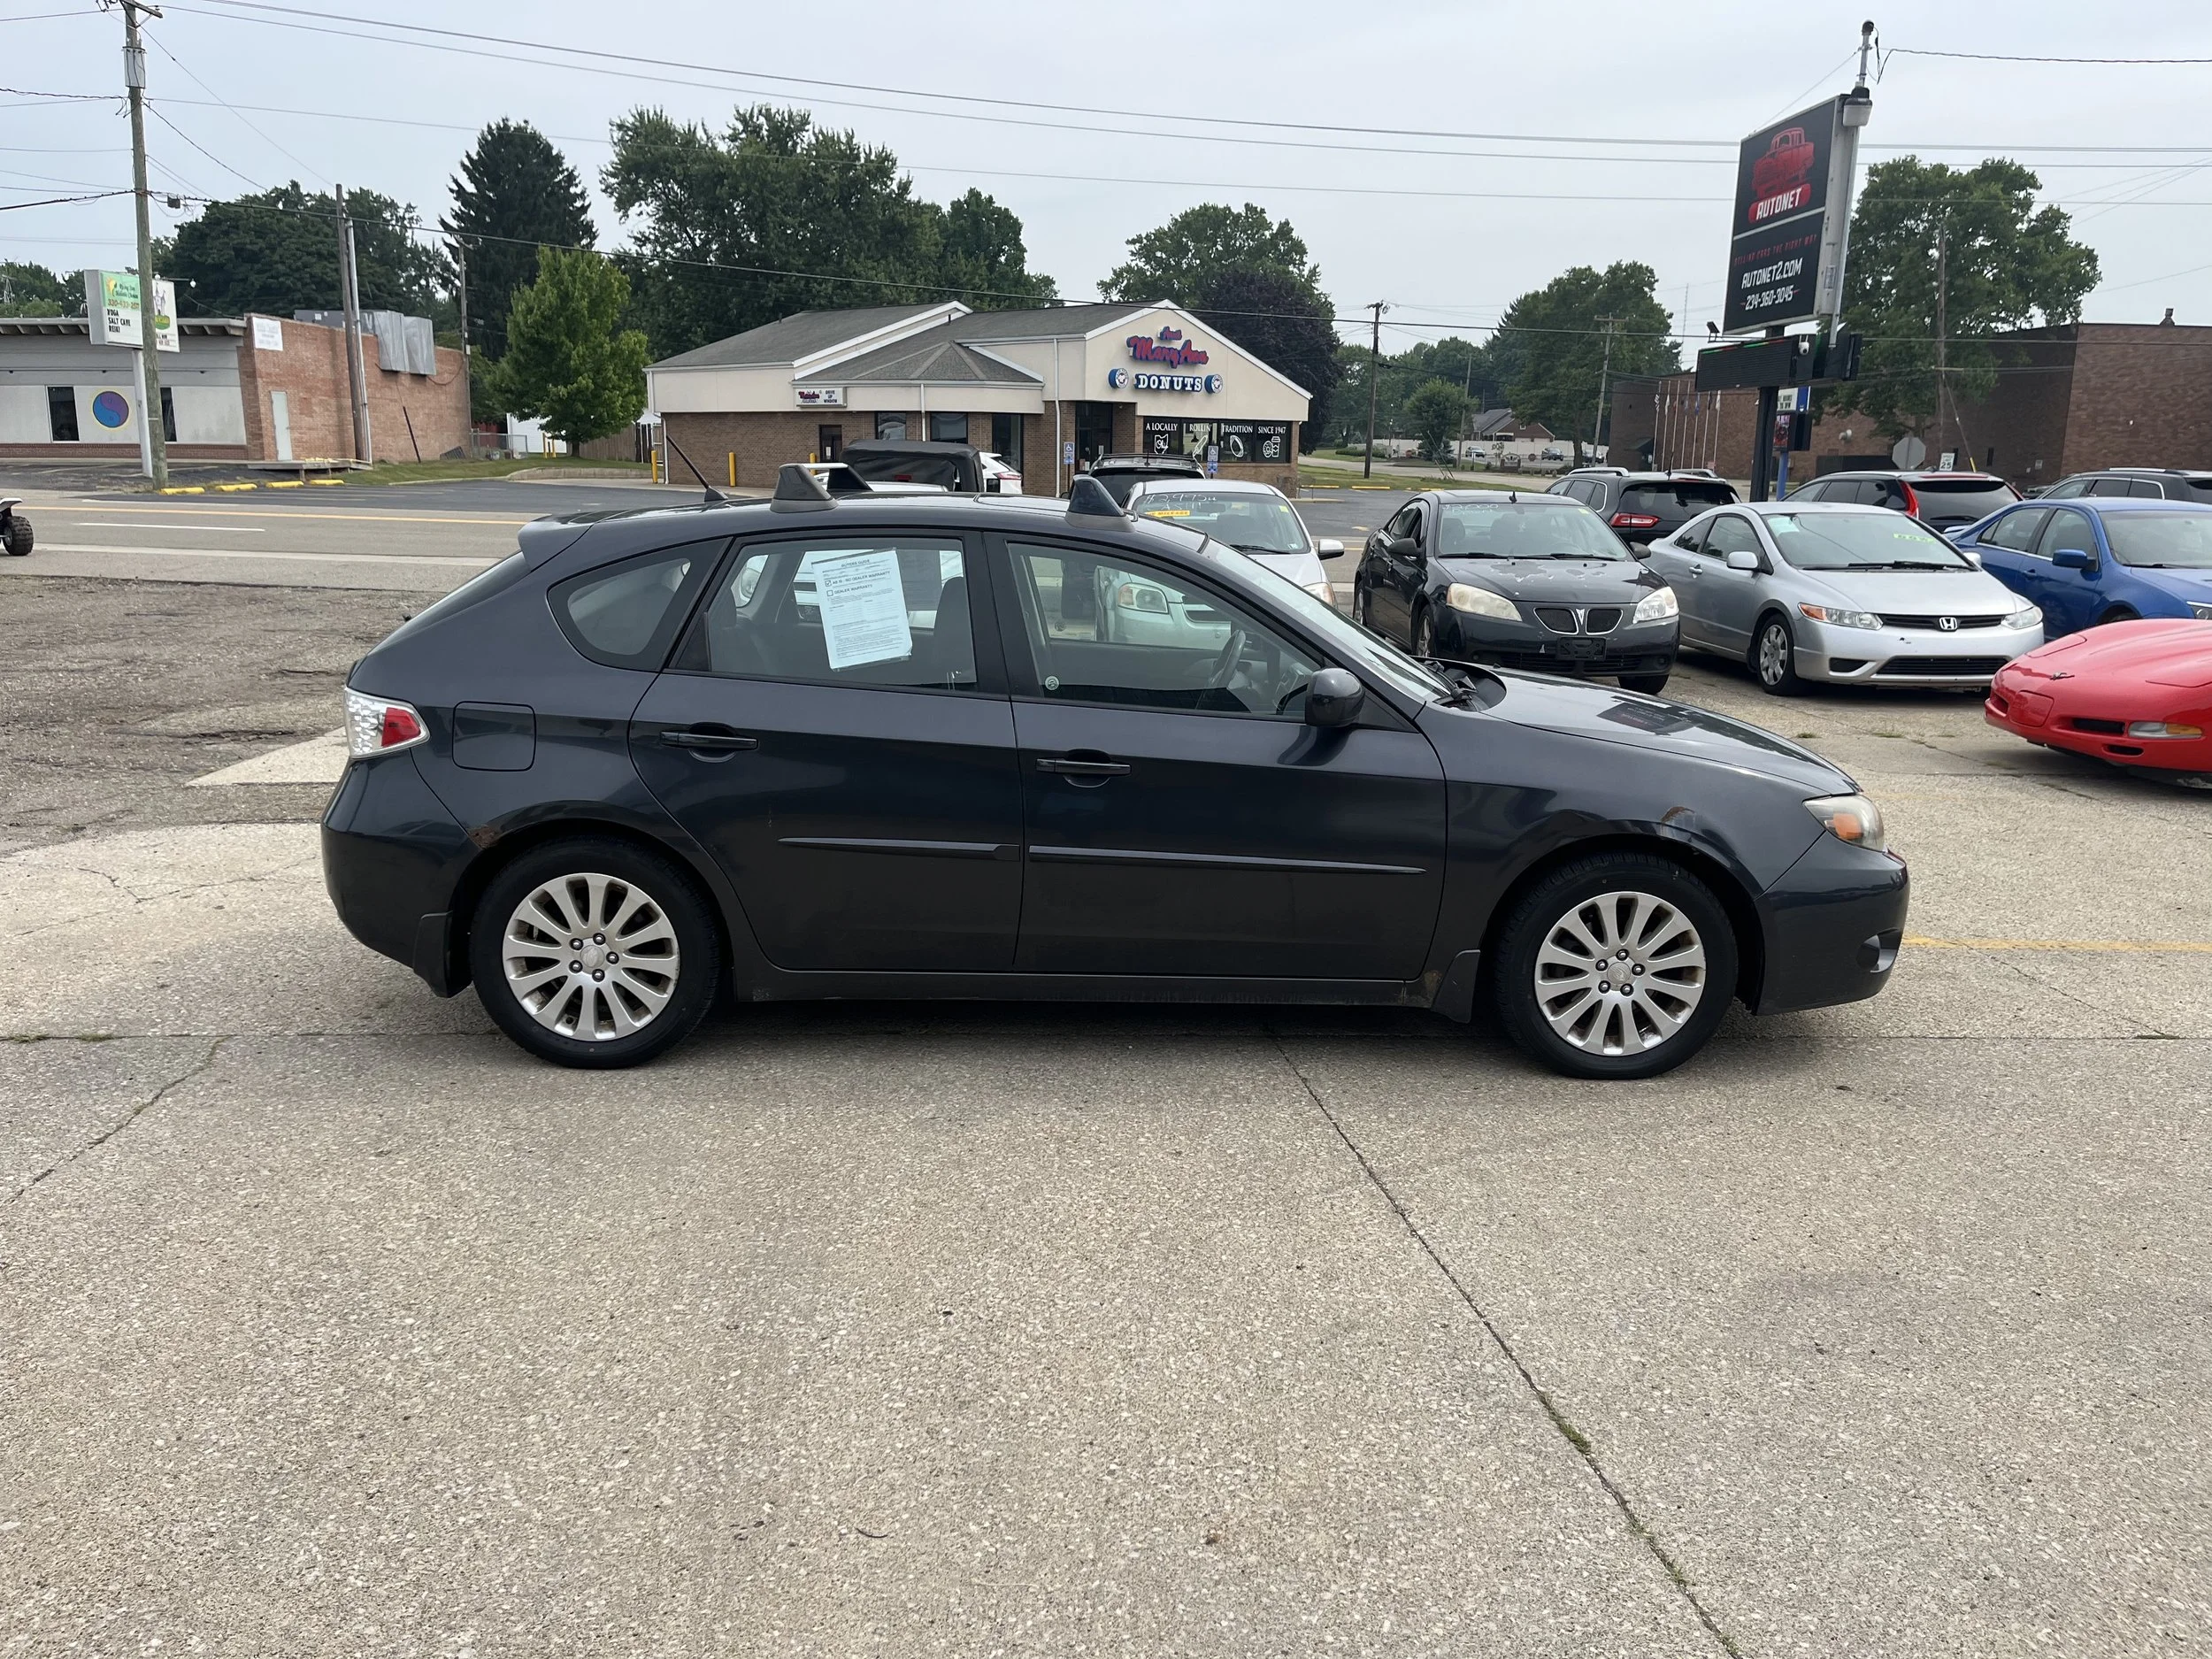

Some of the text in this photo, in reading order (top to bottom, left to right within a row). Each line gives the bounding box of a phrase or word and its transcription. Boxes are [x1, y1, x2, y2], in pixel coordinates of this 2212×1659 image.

[1755, 188, 1802, 220] AUTONET
[1741, 257, 1803, 289] AUTONET2.COM
[1745, 285, 1794, 311] 234-360-3045
[1126, 335, 1210, 369] Mary Ann
[1138, 374, 1202, 390] DONUTS
[1152, 422, 1178, 431] LOCALLY
[1222, 425, 1253, 434] TRADITION
[1257, 426, 1274, 434] SINCE
[1940, 461, 1952, 470] 25
